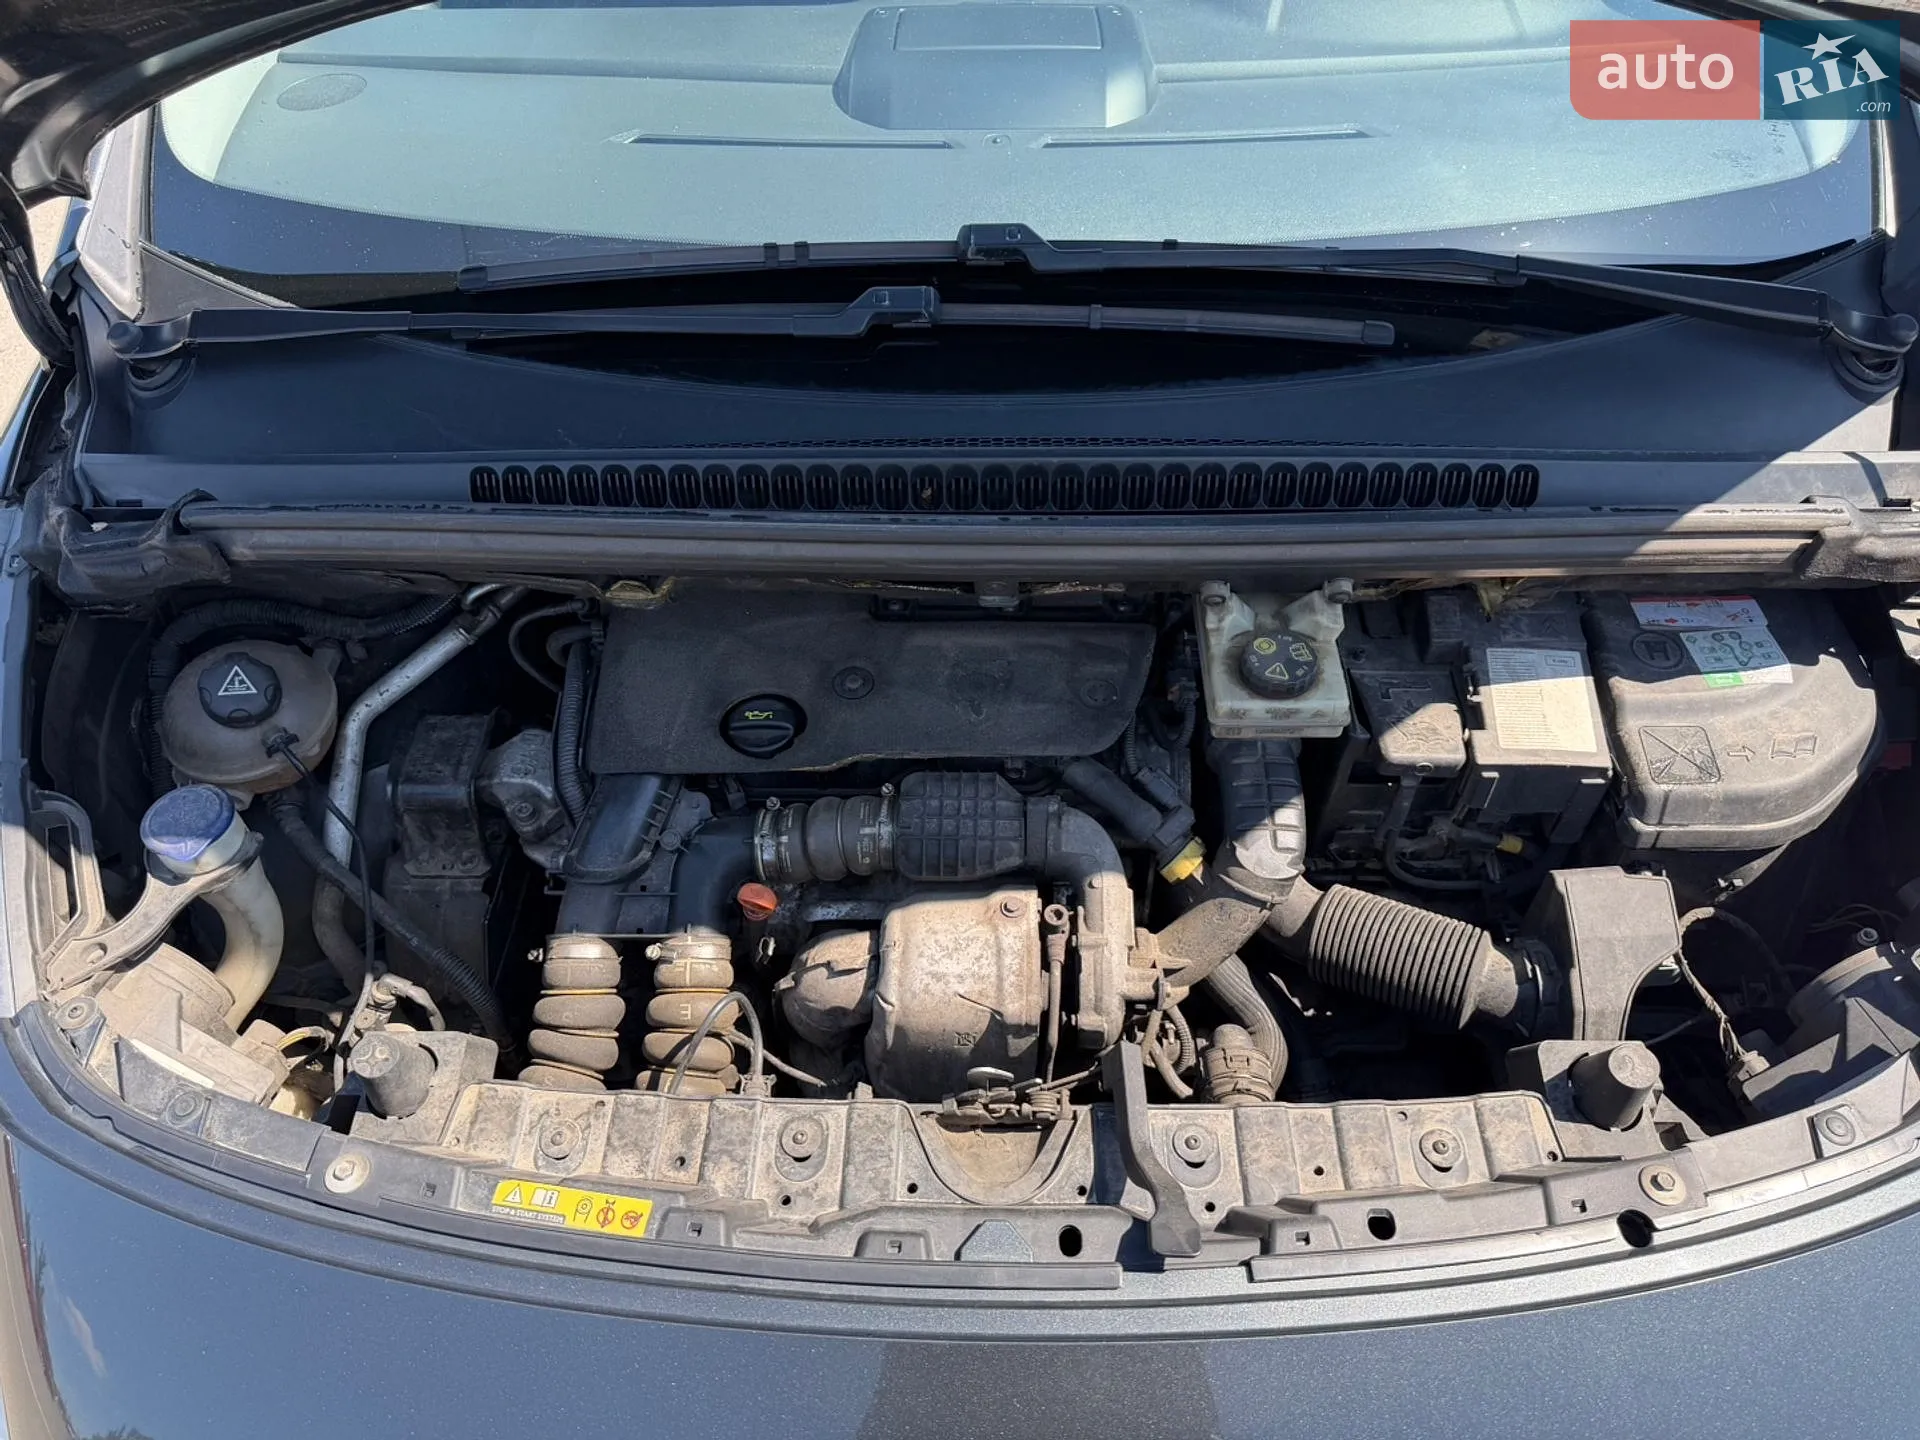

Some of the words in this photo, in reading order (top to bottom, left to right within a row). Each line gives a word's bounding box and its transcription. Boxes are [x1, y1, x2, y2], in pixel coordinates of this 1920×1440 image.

[491, 1206, 509, 1215] STOP
[516, 1209, 536, 1220] START
[537, 1213, 564, 1224] SYSTEM
